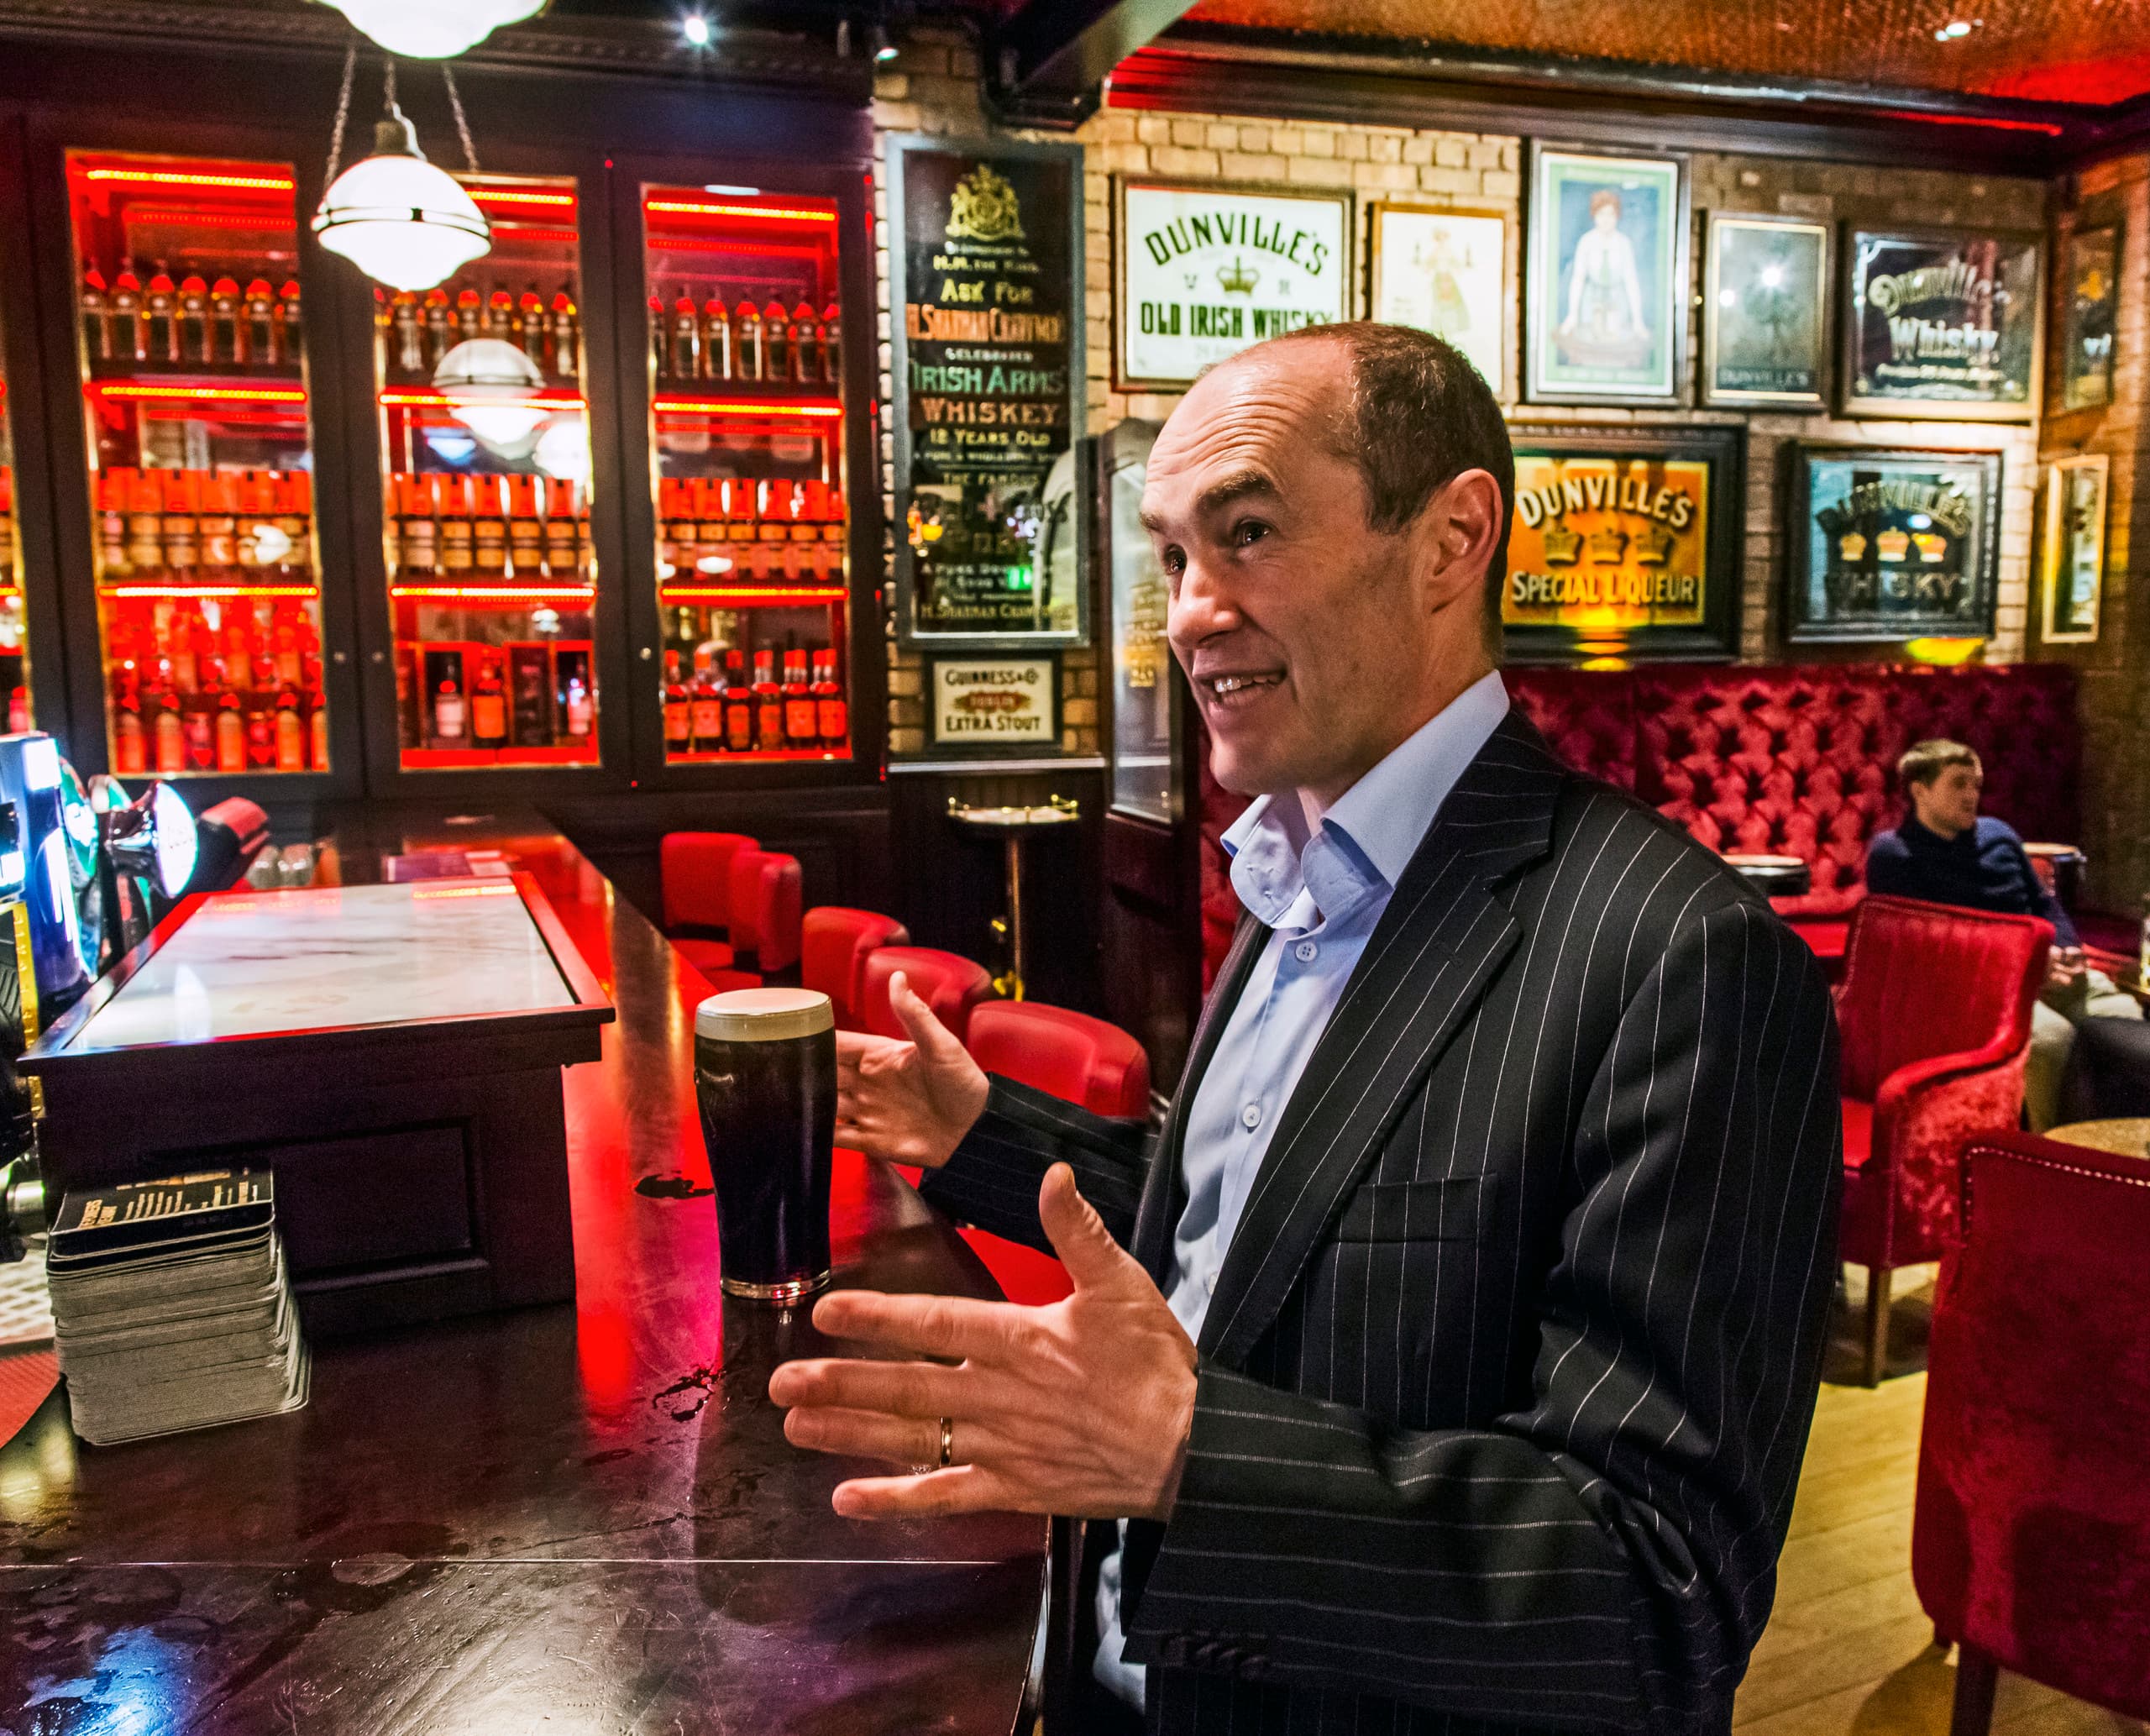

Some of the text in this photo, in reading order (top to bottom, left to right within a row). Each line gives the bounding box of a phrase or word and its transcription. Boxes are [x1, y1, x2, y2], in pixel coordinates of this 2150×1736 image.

[1145, 212, 1328, 276] DUNVILLE'S
[1141, 302, 1181, 336] OLD
[1191, 304, 1243, 338] IRISH
[912, 365, 982, 393] IRISH
[920, 397, 1059, 425] WHISKEY
[954, 429, 1009, 446] YEARS
[1015, 430, 1051, 447] OLD
[1516, 474, 1695, 528] DUNVILLE'S
[1512, 570, 1695, 606] SPECIAL LIQUEUR
[945, 669, 1015, 686] GUINNESS
[946, 716, 1041, 732] EXTRA STOUT
